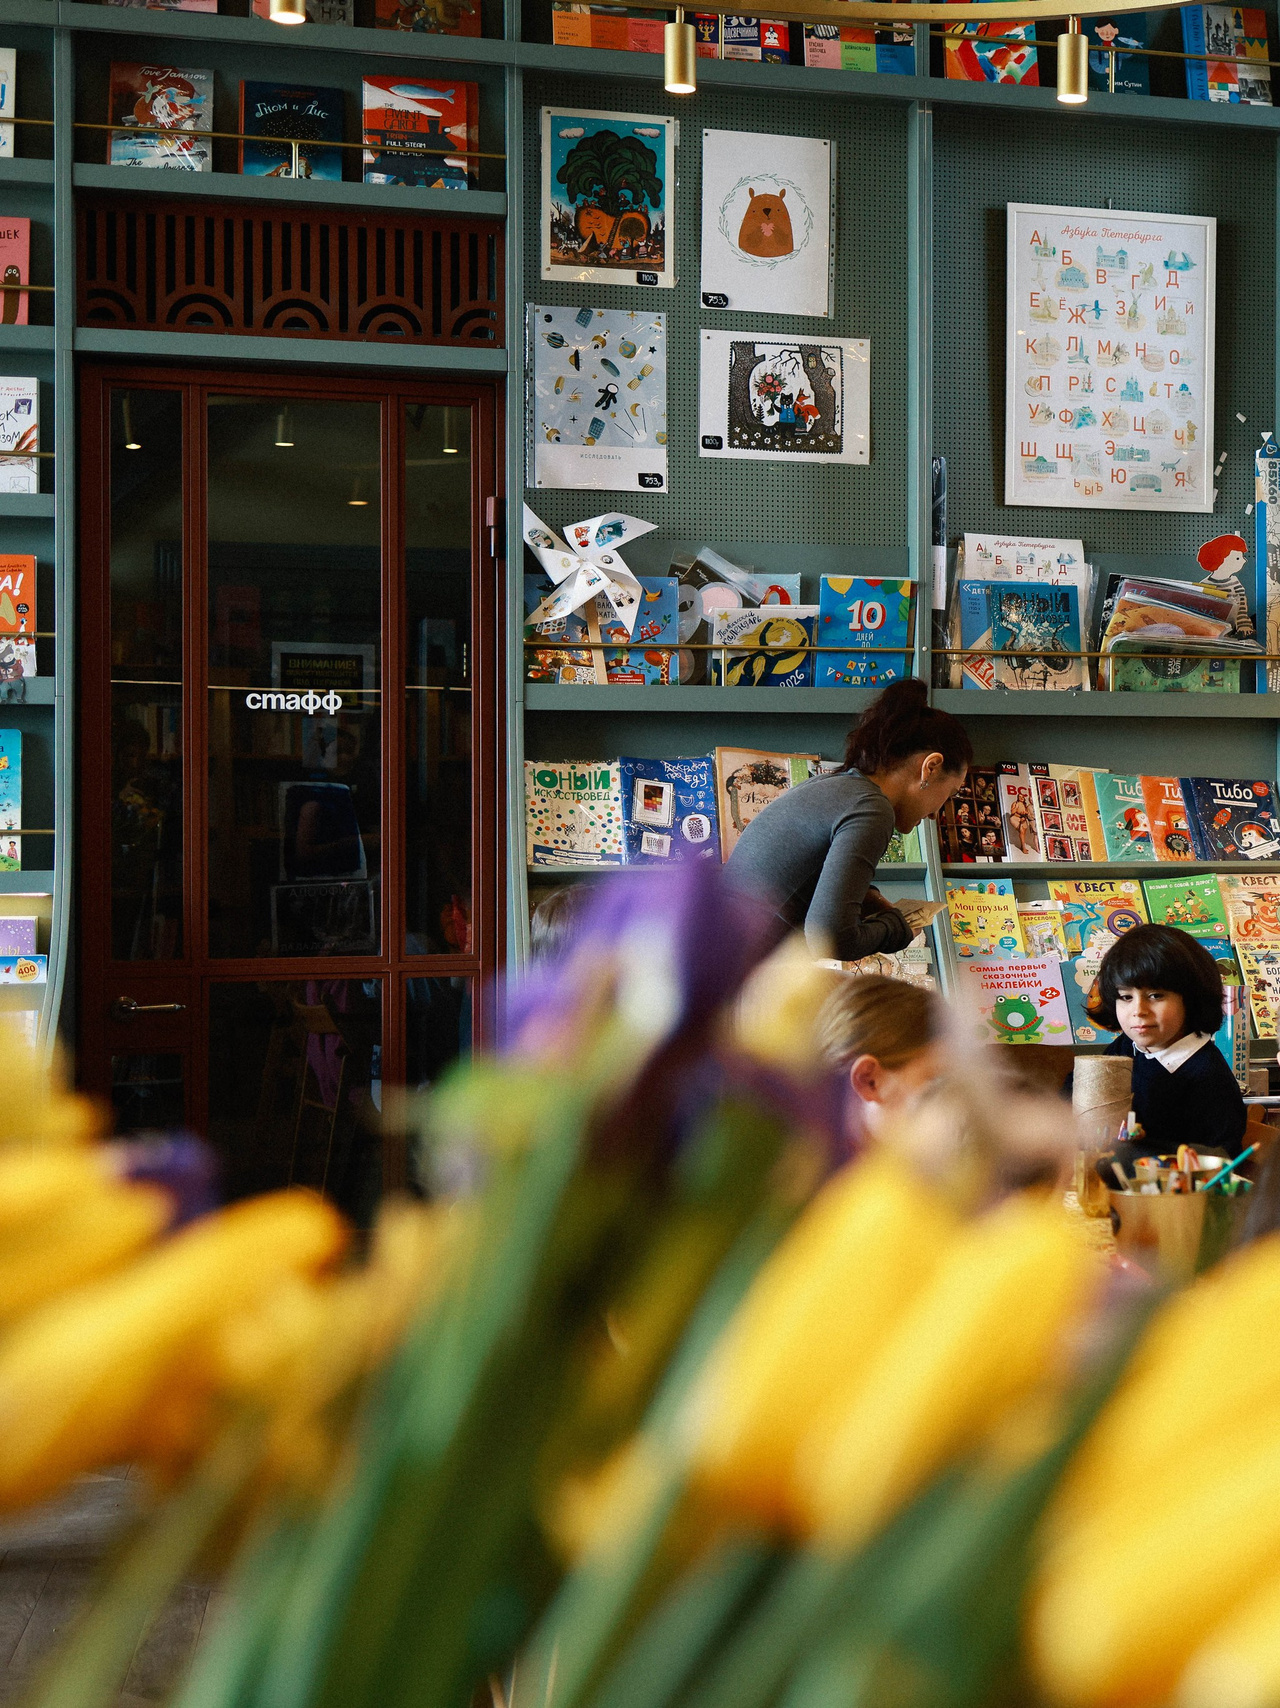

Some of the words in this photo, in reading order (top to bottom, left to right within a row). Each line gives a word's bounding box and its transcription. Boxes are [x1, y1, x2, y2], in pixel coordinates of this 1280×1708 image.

[723, 27, 758, 39] ОДСВЕЧНИКОВ
[140, 66, 161, 76] Tove
[158, 68, 207, 80] Jansson
[1029, 230, 1042, 246] А
[1061, 225, 1098, 240] Азбука
[1101, 227, 1163, 244] Петербурга
[1061, 250, 1072, 266] Б
[1096, 269, 1107, 285] В
[1131, 274, 1140, 290] Г
[1166, 270, 1179, 288] Д
[1029, 292, 1040, 308] Е
[1115, 300, 1126, 316] З
[1155, 295, 1166, 311] И
[1067, 307, 1087, 324] Ж
[1026, 338, 1038, 354] К
[1065, 336, 1078, 352] Л
[1098, 340, 1111, 355] М
[1135, 342, 1147, 357] Н
[1169, 349, 1180, 365] О
[1039, 375, 1051, 391] П
[1069, 376, 1079, 392] Р
[1106, 377, 1116, 393] С
[1163, 383, 1174, 399] Т
[1028, 403, 1040, 419] У
[1058, 409, 1074, 424] Ф
[1101, 411, 1113, 427] Х
[1133, 417, 1146, 434] Ц
[1174, 430, 1185, 445] Ч
[1021, 441, 1037, 457] Ш
[1055, 443, 1074, 462] Щ
[1105, 440, 1115, 456] Э
[580, 453, 622, 461] ИССЛЕДОВАТЬ
[1111, 468, 1127, 484] Ю
[1174, 472, 1186, 487] Я
[976, 543, 984, 552] А
[994, 540, 1017, 548] Азбука
[1018, 541, 1056, 550] Петербурга
[995, 555, 1003, 565] Б
[1016, 565, 1023, 575] В
[1058, 564, 1068, 575] Д
[847, 599, 886, 631] 10
[855, 632, 874, 642] ДНЕЙ
[532, 765, 611, 791] ЮНЫЙ
[534, 788, 611, 801] ИСКУССТВОВЕД
[1112, 778, 1143, 797] Тиб
[1210, 782, 1253, 800] Тибо
[740, 791, 773, 805] Азб
[1074, 881, 1116, 893] КВЕСТ
[1241, 876, 1278, 887] КВЕСТ
[1204, 888, 1217, 896] 5+
[954, 903, 974, 911] Мои
[976, 905, 1009, 914] друзья
[18, 964, 36, 976] 400
[969, 965, 1005, 973] Самые
[1008, 963, 1047, 972] первые
[982, 971, 1037, 980] сказочные
[981, 979, 1043, 990] НАКЛЕЙКИ
[1045, 989, 1058, 997] 2+
